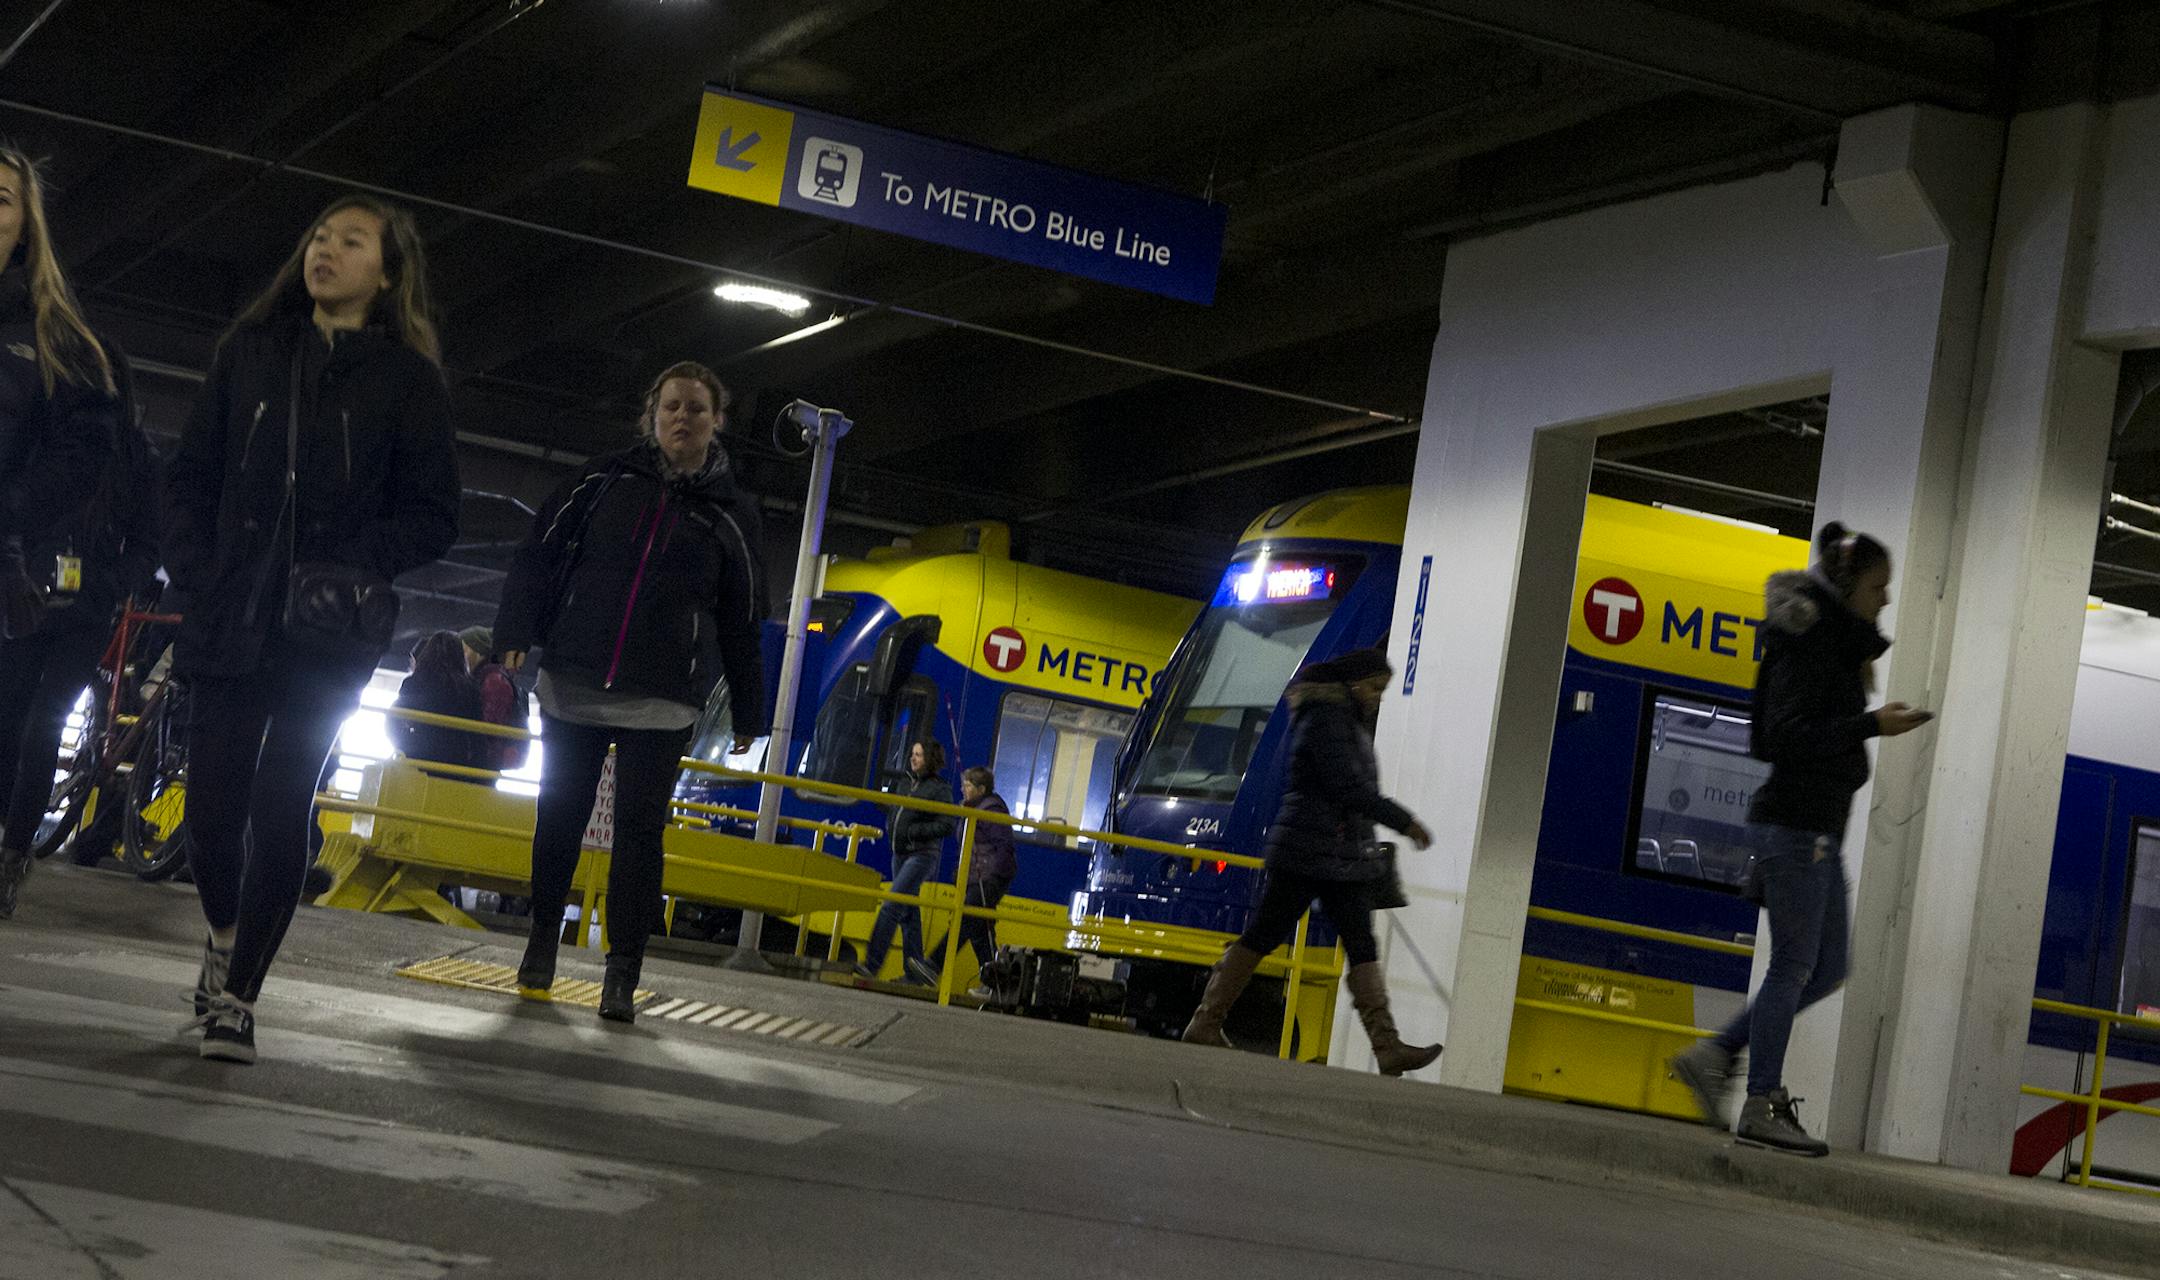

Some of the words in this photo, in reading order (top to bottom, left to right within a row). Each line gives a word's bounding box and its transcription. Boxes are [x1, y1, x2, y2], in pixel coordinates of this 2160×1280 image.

[880, 172, 914, 206] To
[923, 181, 1036, 233] METRO
[1045, 210, 1106, 252] Blue
[1114, 227, 1172, 266] Line
[1660, 600, 1767, 662] MET
[1184, 816, 1220, 836] 213A
